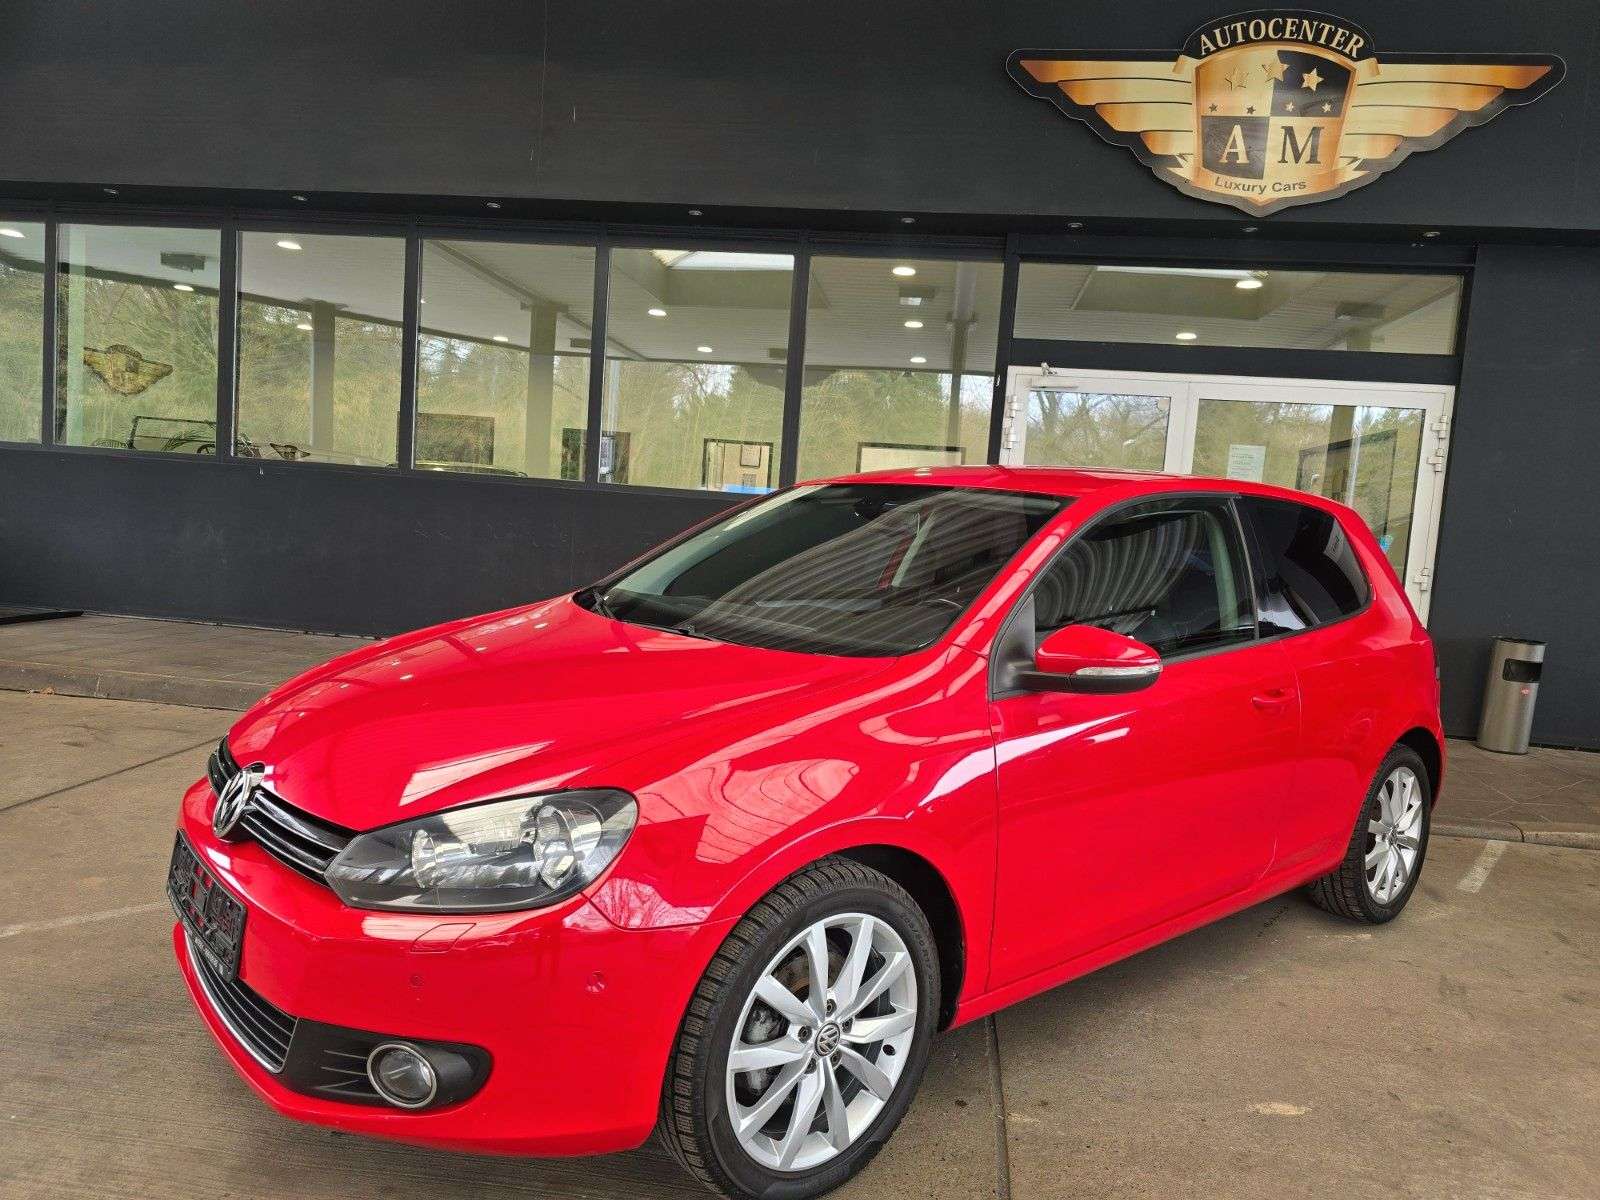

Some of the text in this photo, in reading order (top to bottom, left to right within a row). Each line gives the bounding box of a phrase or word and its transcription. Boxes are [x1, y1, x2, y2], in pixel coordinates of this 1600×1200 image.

[1200, 18, 1364, 57] AUTOCENTER
[1219, 125, 1324, 164] A M
[1215, 176, 1307, 195] Luxury Cars
